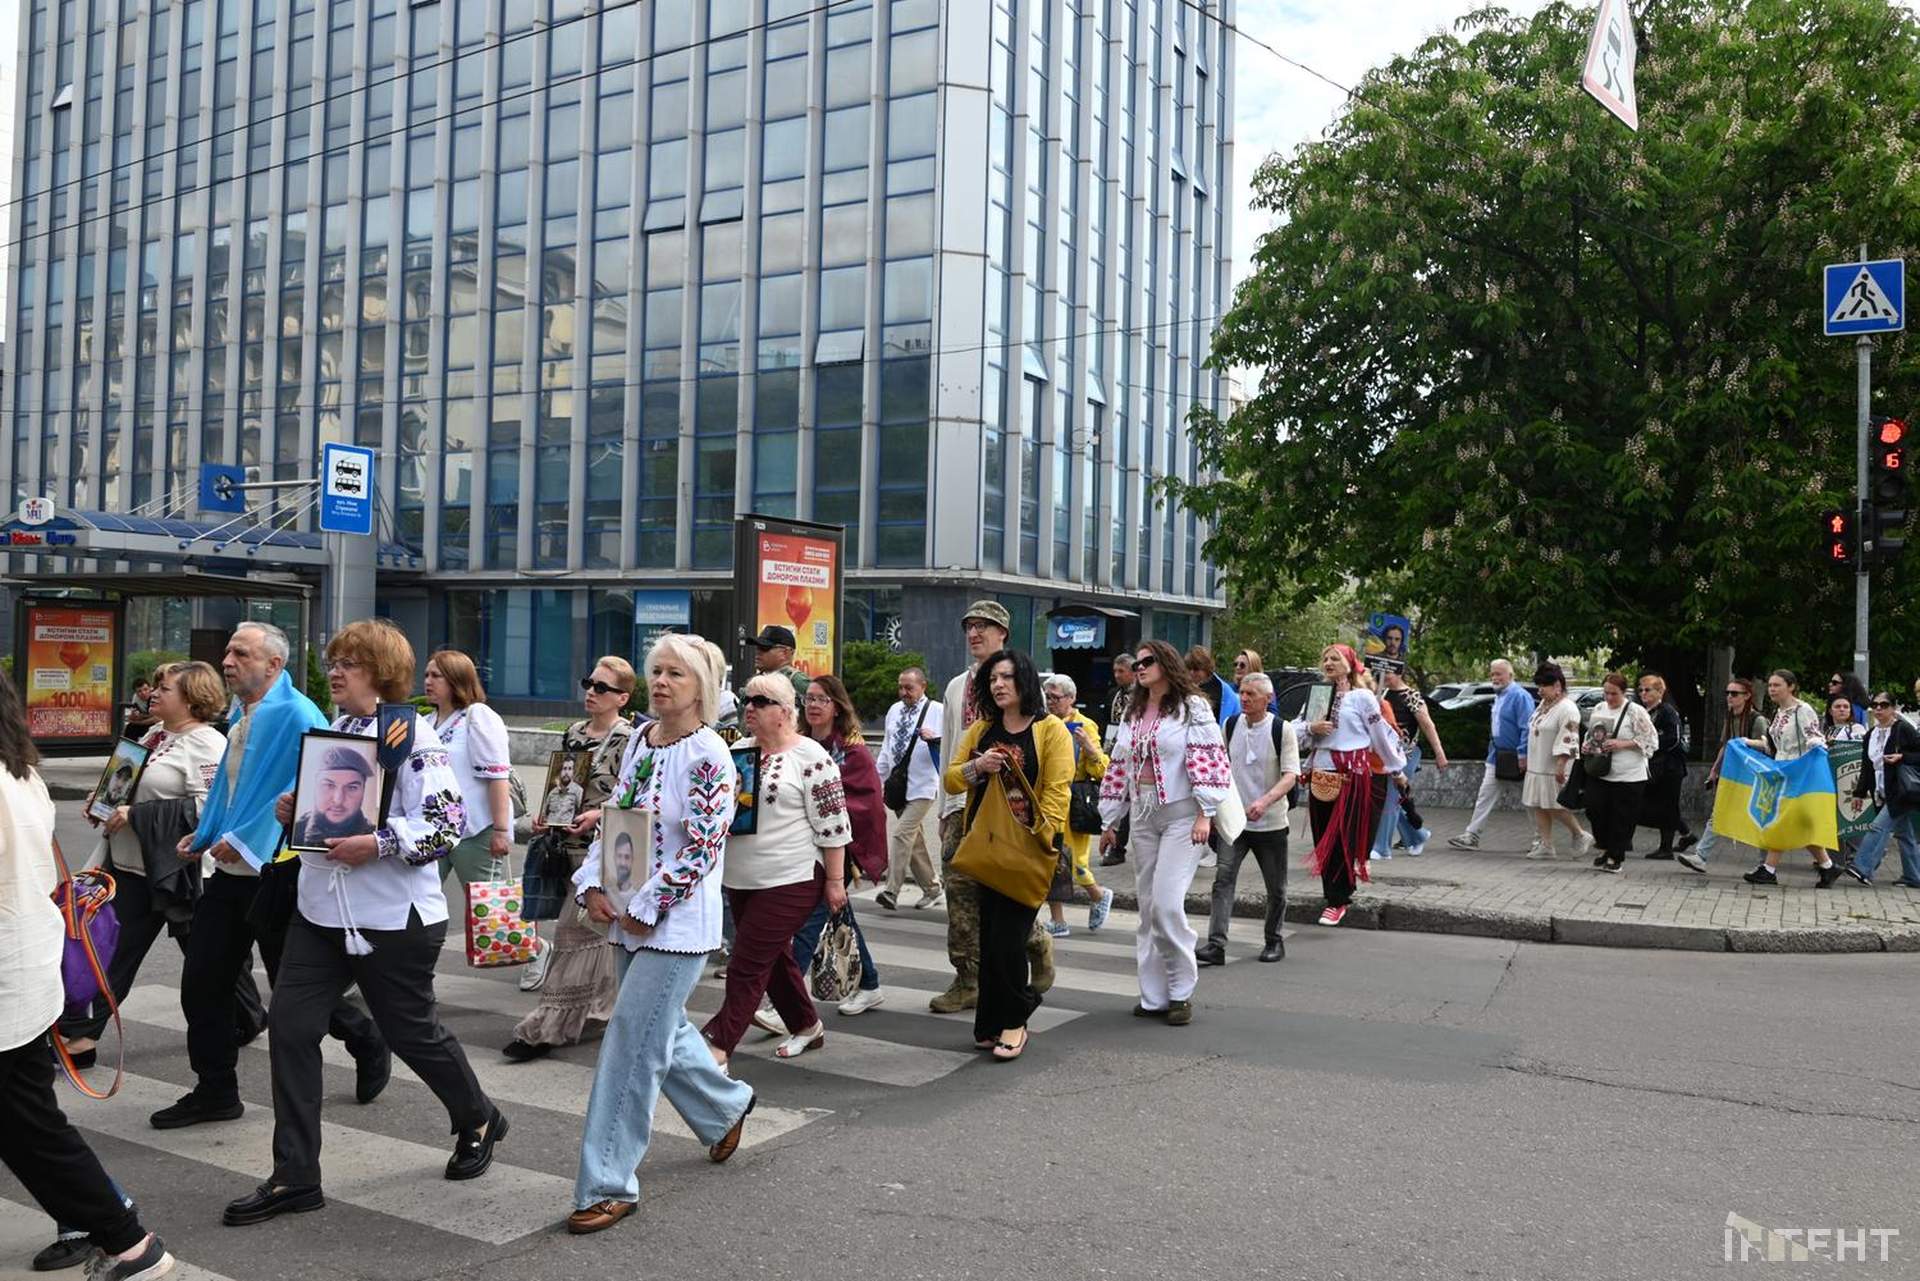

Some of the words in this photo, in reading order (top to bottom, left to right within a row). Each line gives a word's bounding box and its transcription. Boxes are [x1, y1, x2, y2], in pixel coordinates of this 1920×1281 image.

[802, 566, 821, 576] СТАТИ
[767, 572, 799, 582] ДОНОРОМ
[51, 691, 87, 707] 1000
